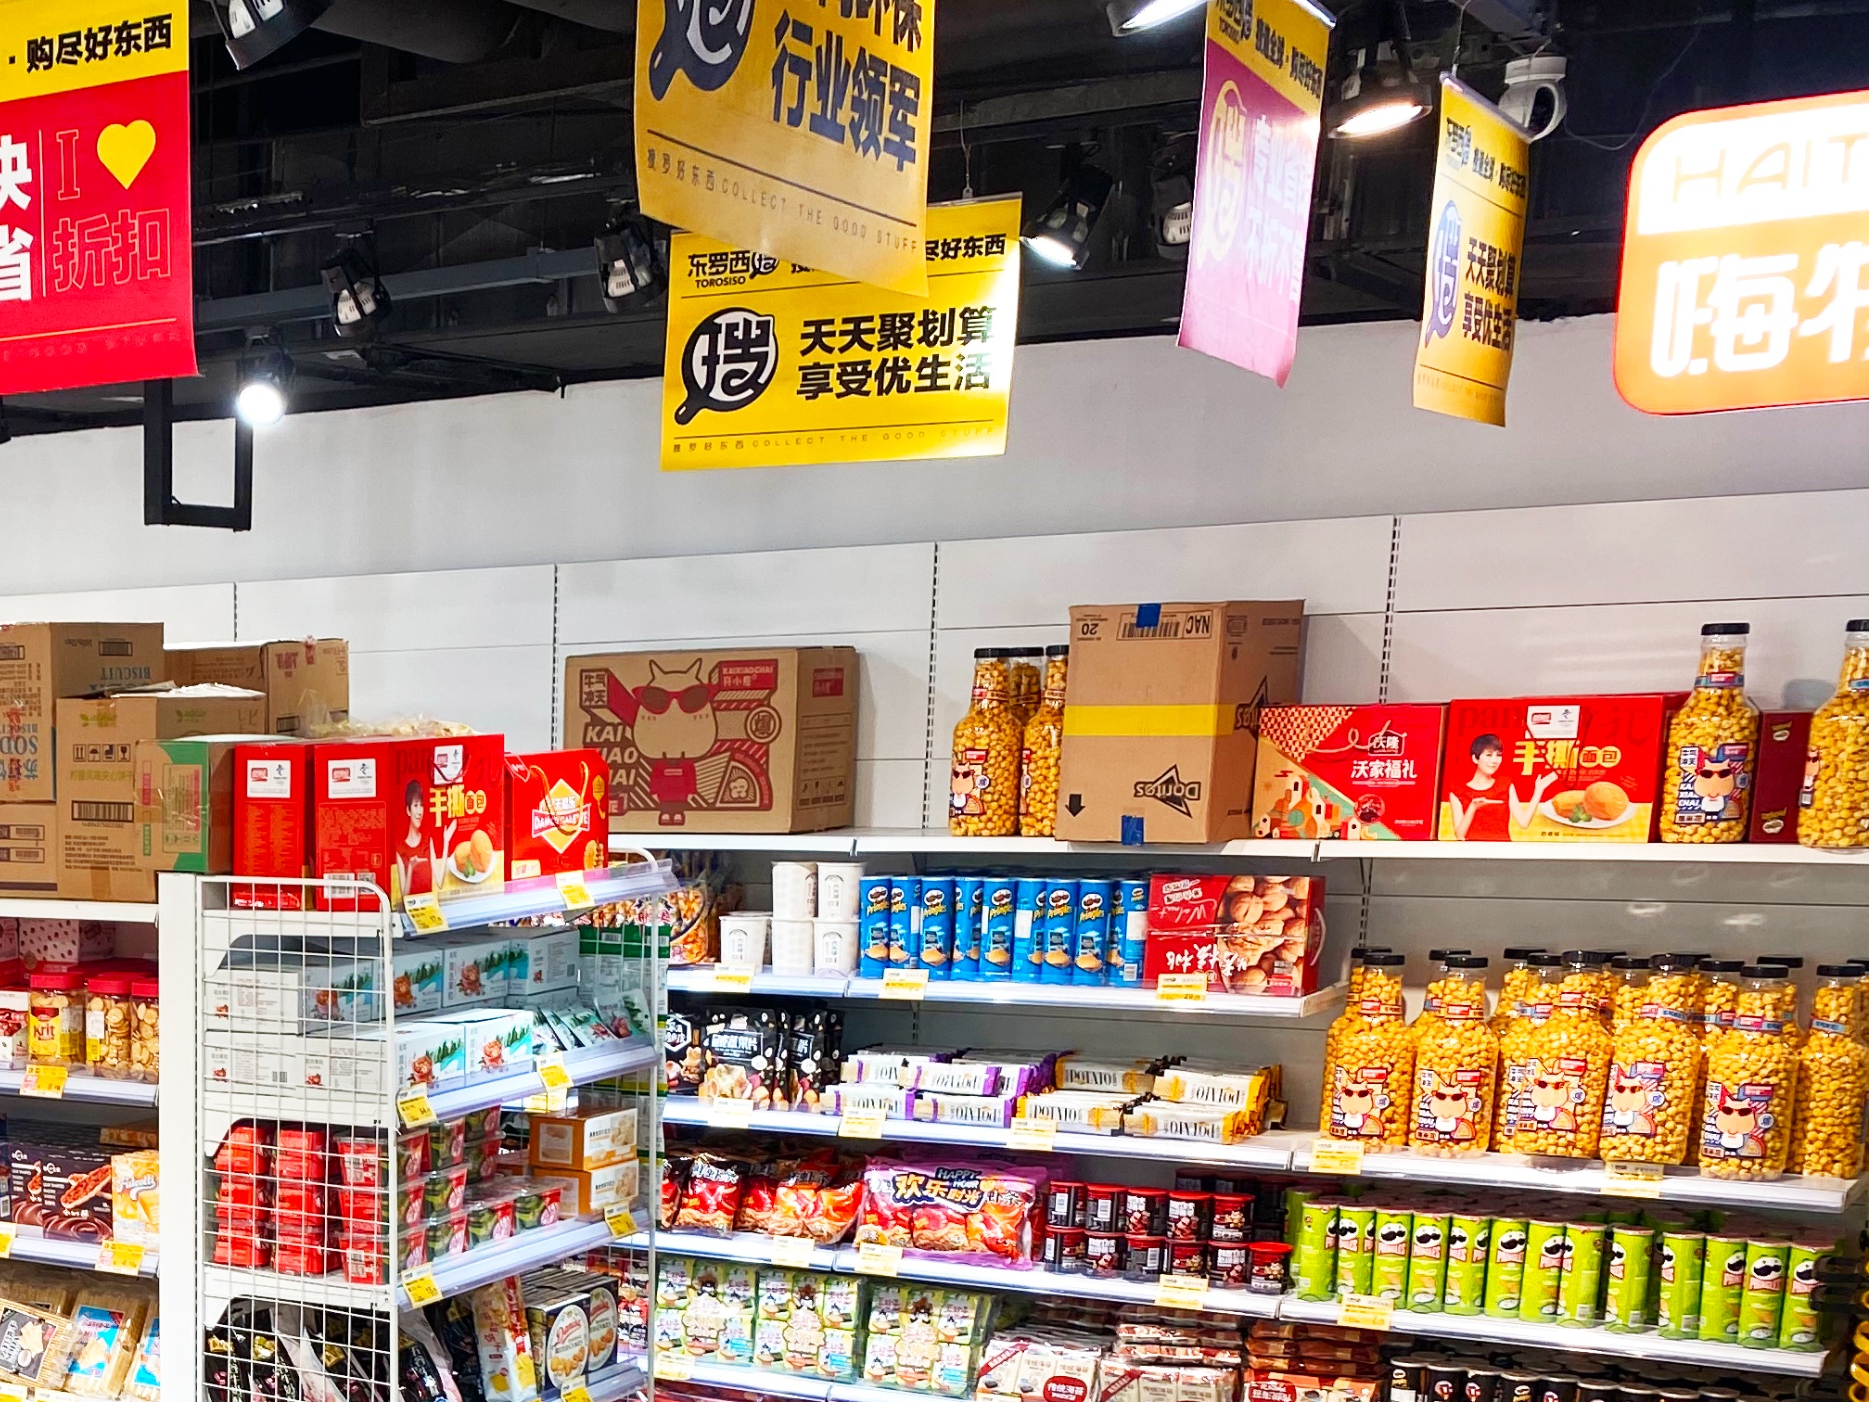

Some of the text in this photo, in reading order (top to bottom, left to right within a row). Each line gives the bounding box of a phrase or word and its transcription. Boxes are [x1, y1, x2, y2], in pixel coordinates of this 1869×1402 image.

[770, 7, 925, 172] 行业领军
[721, 176, 789, 214] COLLECT
[798, 202, 824, 227] THE
[832, 215, 869, 240] GOOD
[876, 228, 920, 255] STUFF
[54, 207, 173, 293] 折扣
[687, 250, 751, 279] 东罗西
[694, 274, 747, 290] TOROSISO
[799, 304, 998, 358] 天天聚划算
[795, 351, 992, 402] 享受优生活
[1081, 623, 1099, 636] 20
[1185, 614, 1211, 634] NAC
[722, 665, 775, 675] KAIXIAOCHAI
[585, 725, 622, 744] KAI
[1350, 759, 1419, 780] 沃家福礼
[1513, 739, 1622, 776] 手撕面包
[1134, 782, 1201, 801] Doritos
[938, 1167, 977, 1182] HAPPY
[894, 1173, 982, 1206] 欢乐时光
